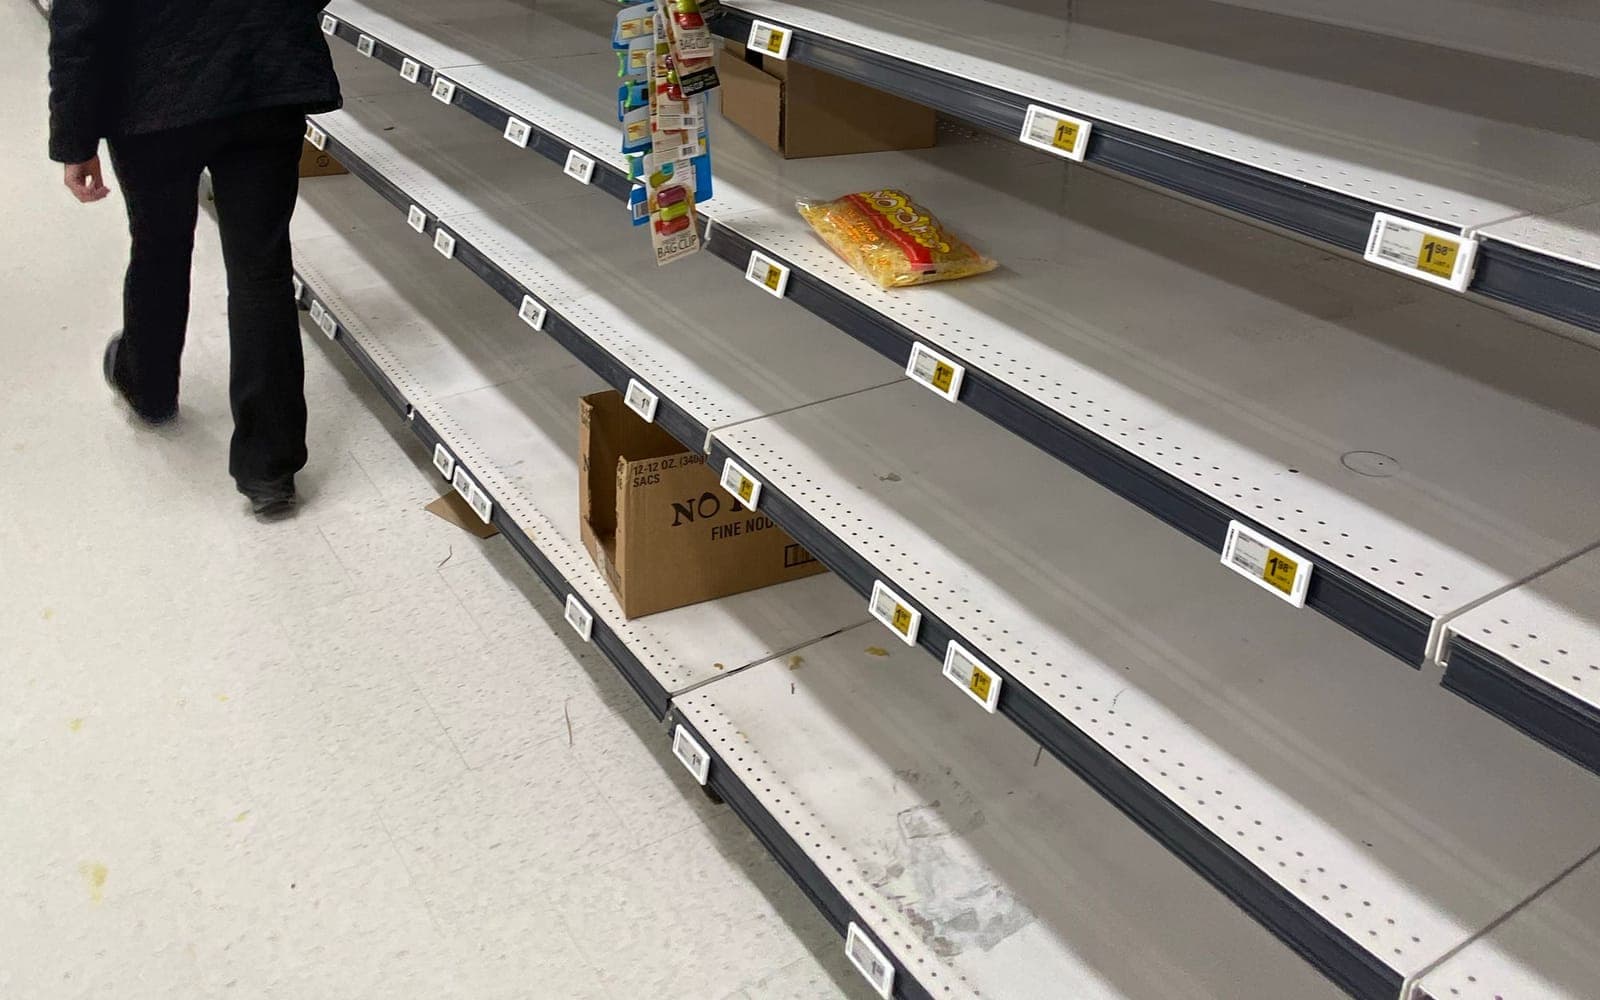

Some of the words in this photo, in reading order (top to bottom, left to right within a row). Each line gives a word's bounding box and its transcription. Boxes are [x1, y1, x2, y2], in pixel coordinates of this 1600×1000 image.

[657, 243, 678, 259] BAG
[633, 462, 659, 476] 12-12
[633, 474, 660, 487] SACS
[671, 491, 720, 527] NO
[711, 521, 742, 541] FINE
